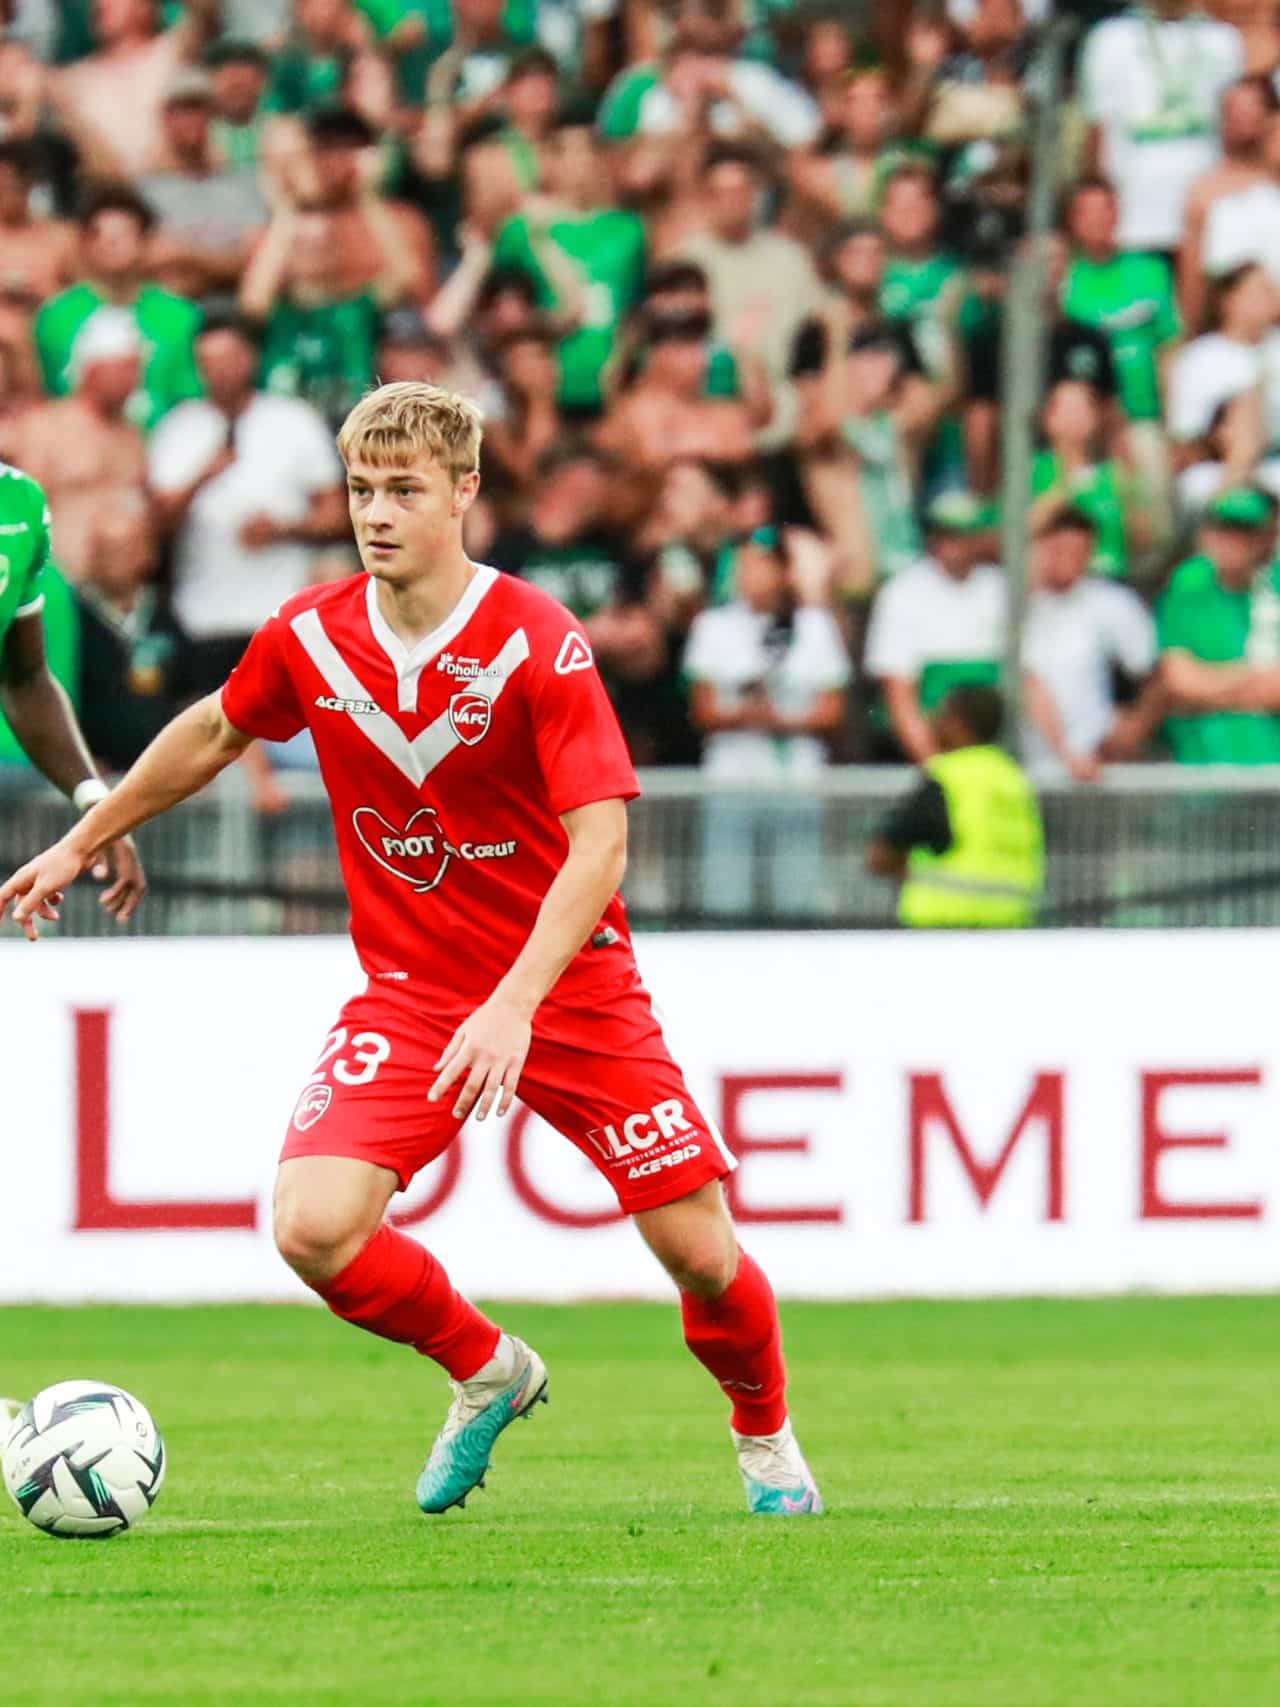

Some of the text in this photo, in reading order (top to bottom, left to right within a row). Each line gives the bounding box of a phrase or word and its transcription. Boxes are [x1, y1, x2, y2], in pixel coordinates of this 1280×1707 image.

[453, 711, 488, 725] VAFC
[308, 1027, 391, 1086] 23
[603, 1098, 693, 1158] LCR
